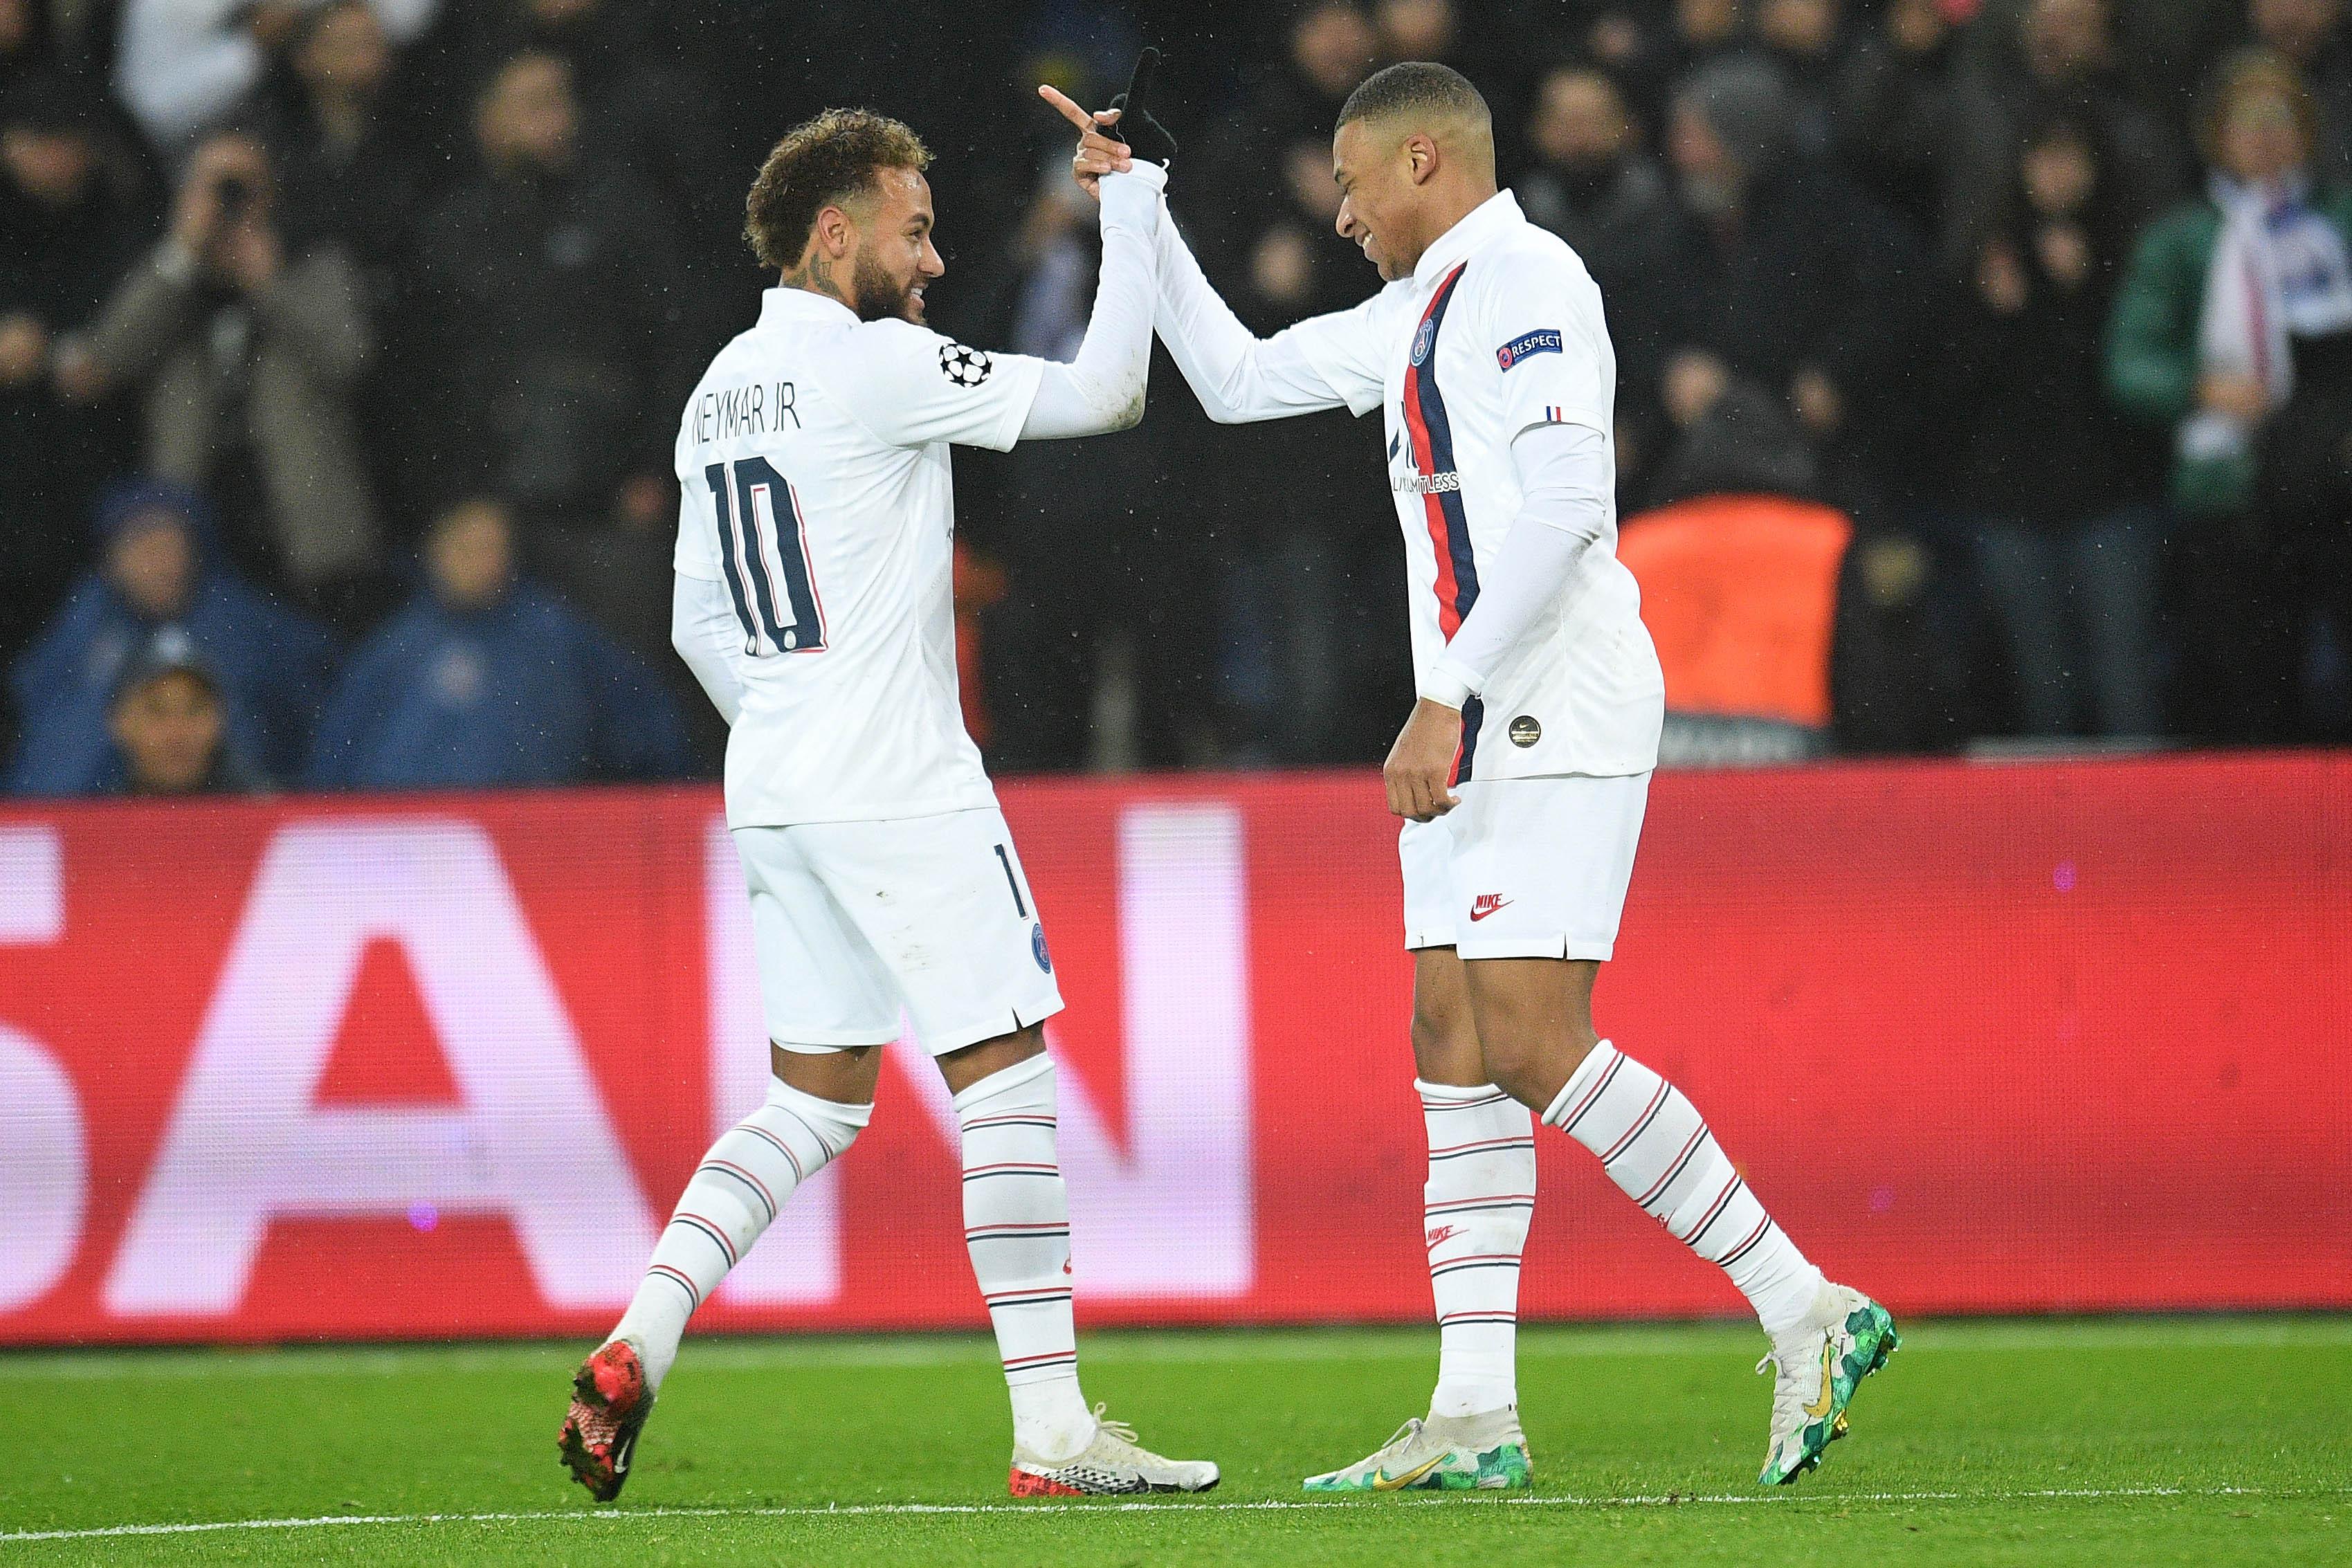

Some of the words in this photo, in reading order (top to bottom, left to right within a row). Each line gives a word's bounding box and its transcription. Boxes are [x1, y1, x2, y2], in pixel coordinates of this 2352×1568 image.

[1511, 335, 1560, 358] RESPECT
[693, 385, 765, 446] NEYMAR
[773, 382, 801, 432] JR
[704, 455, 828, 657] 10
[1475, 893, 1502, 909] NIKE
[0, 804, 1255, 1315] AN
[1428, 1225, 1453, 1241] NIKE
